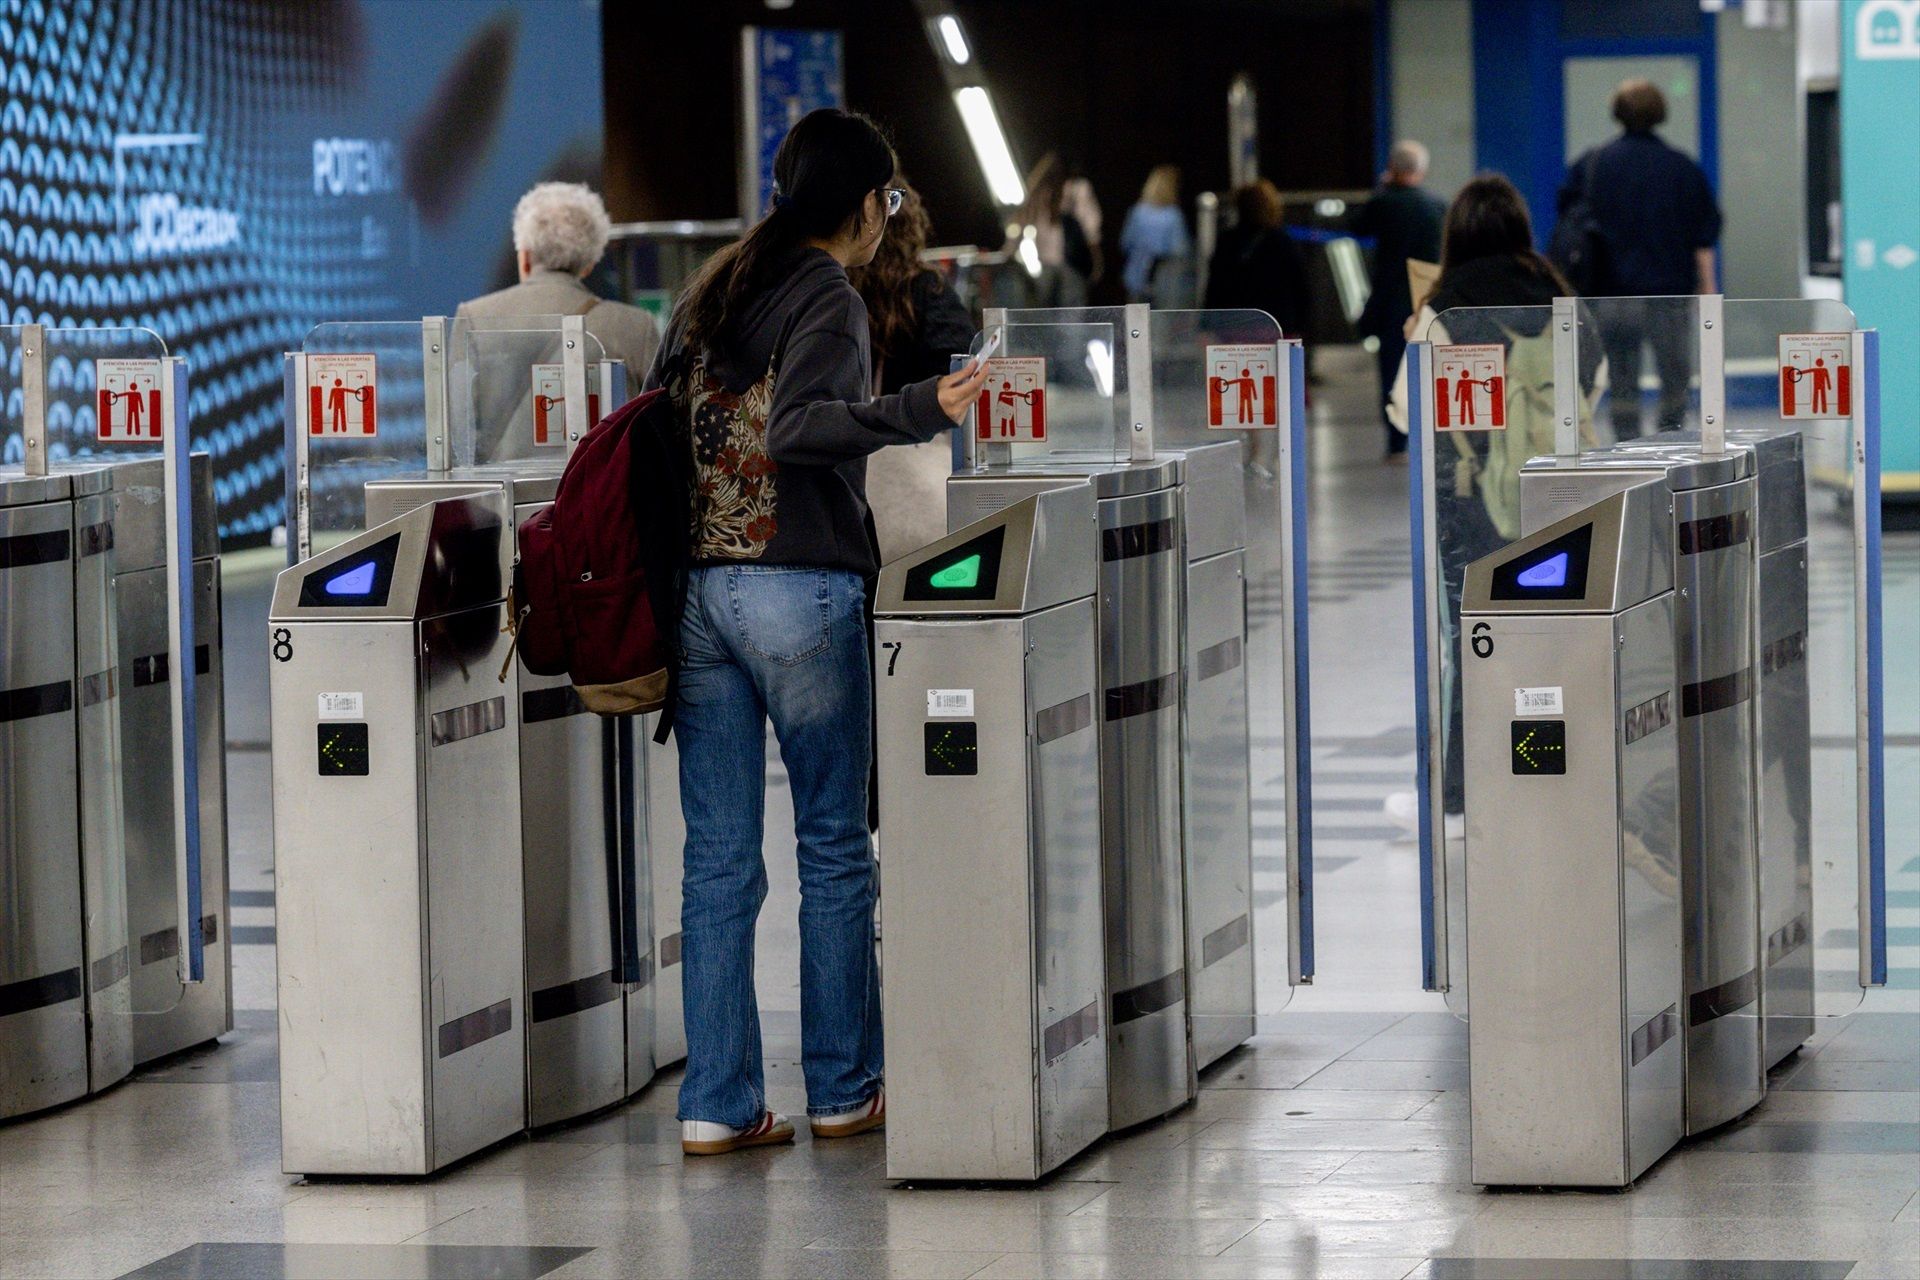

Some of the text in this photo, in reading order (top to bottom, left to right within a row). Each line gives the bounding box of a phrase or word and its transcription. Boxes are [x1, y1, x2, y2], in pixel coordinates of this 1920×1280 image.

[133, 192, 239, 253] JCDecaux
[273, 627, 293, 662] 8
[1471, 621, 1494, 659] 6
[882, 641, 902, 677] 7
